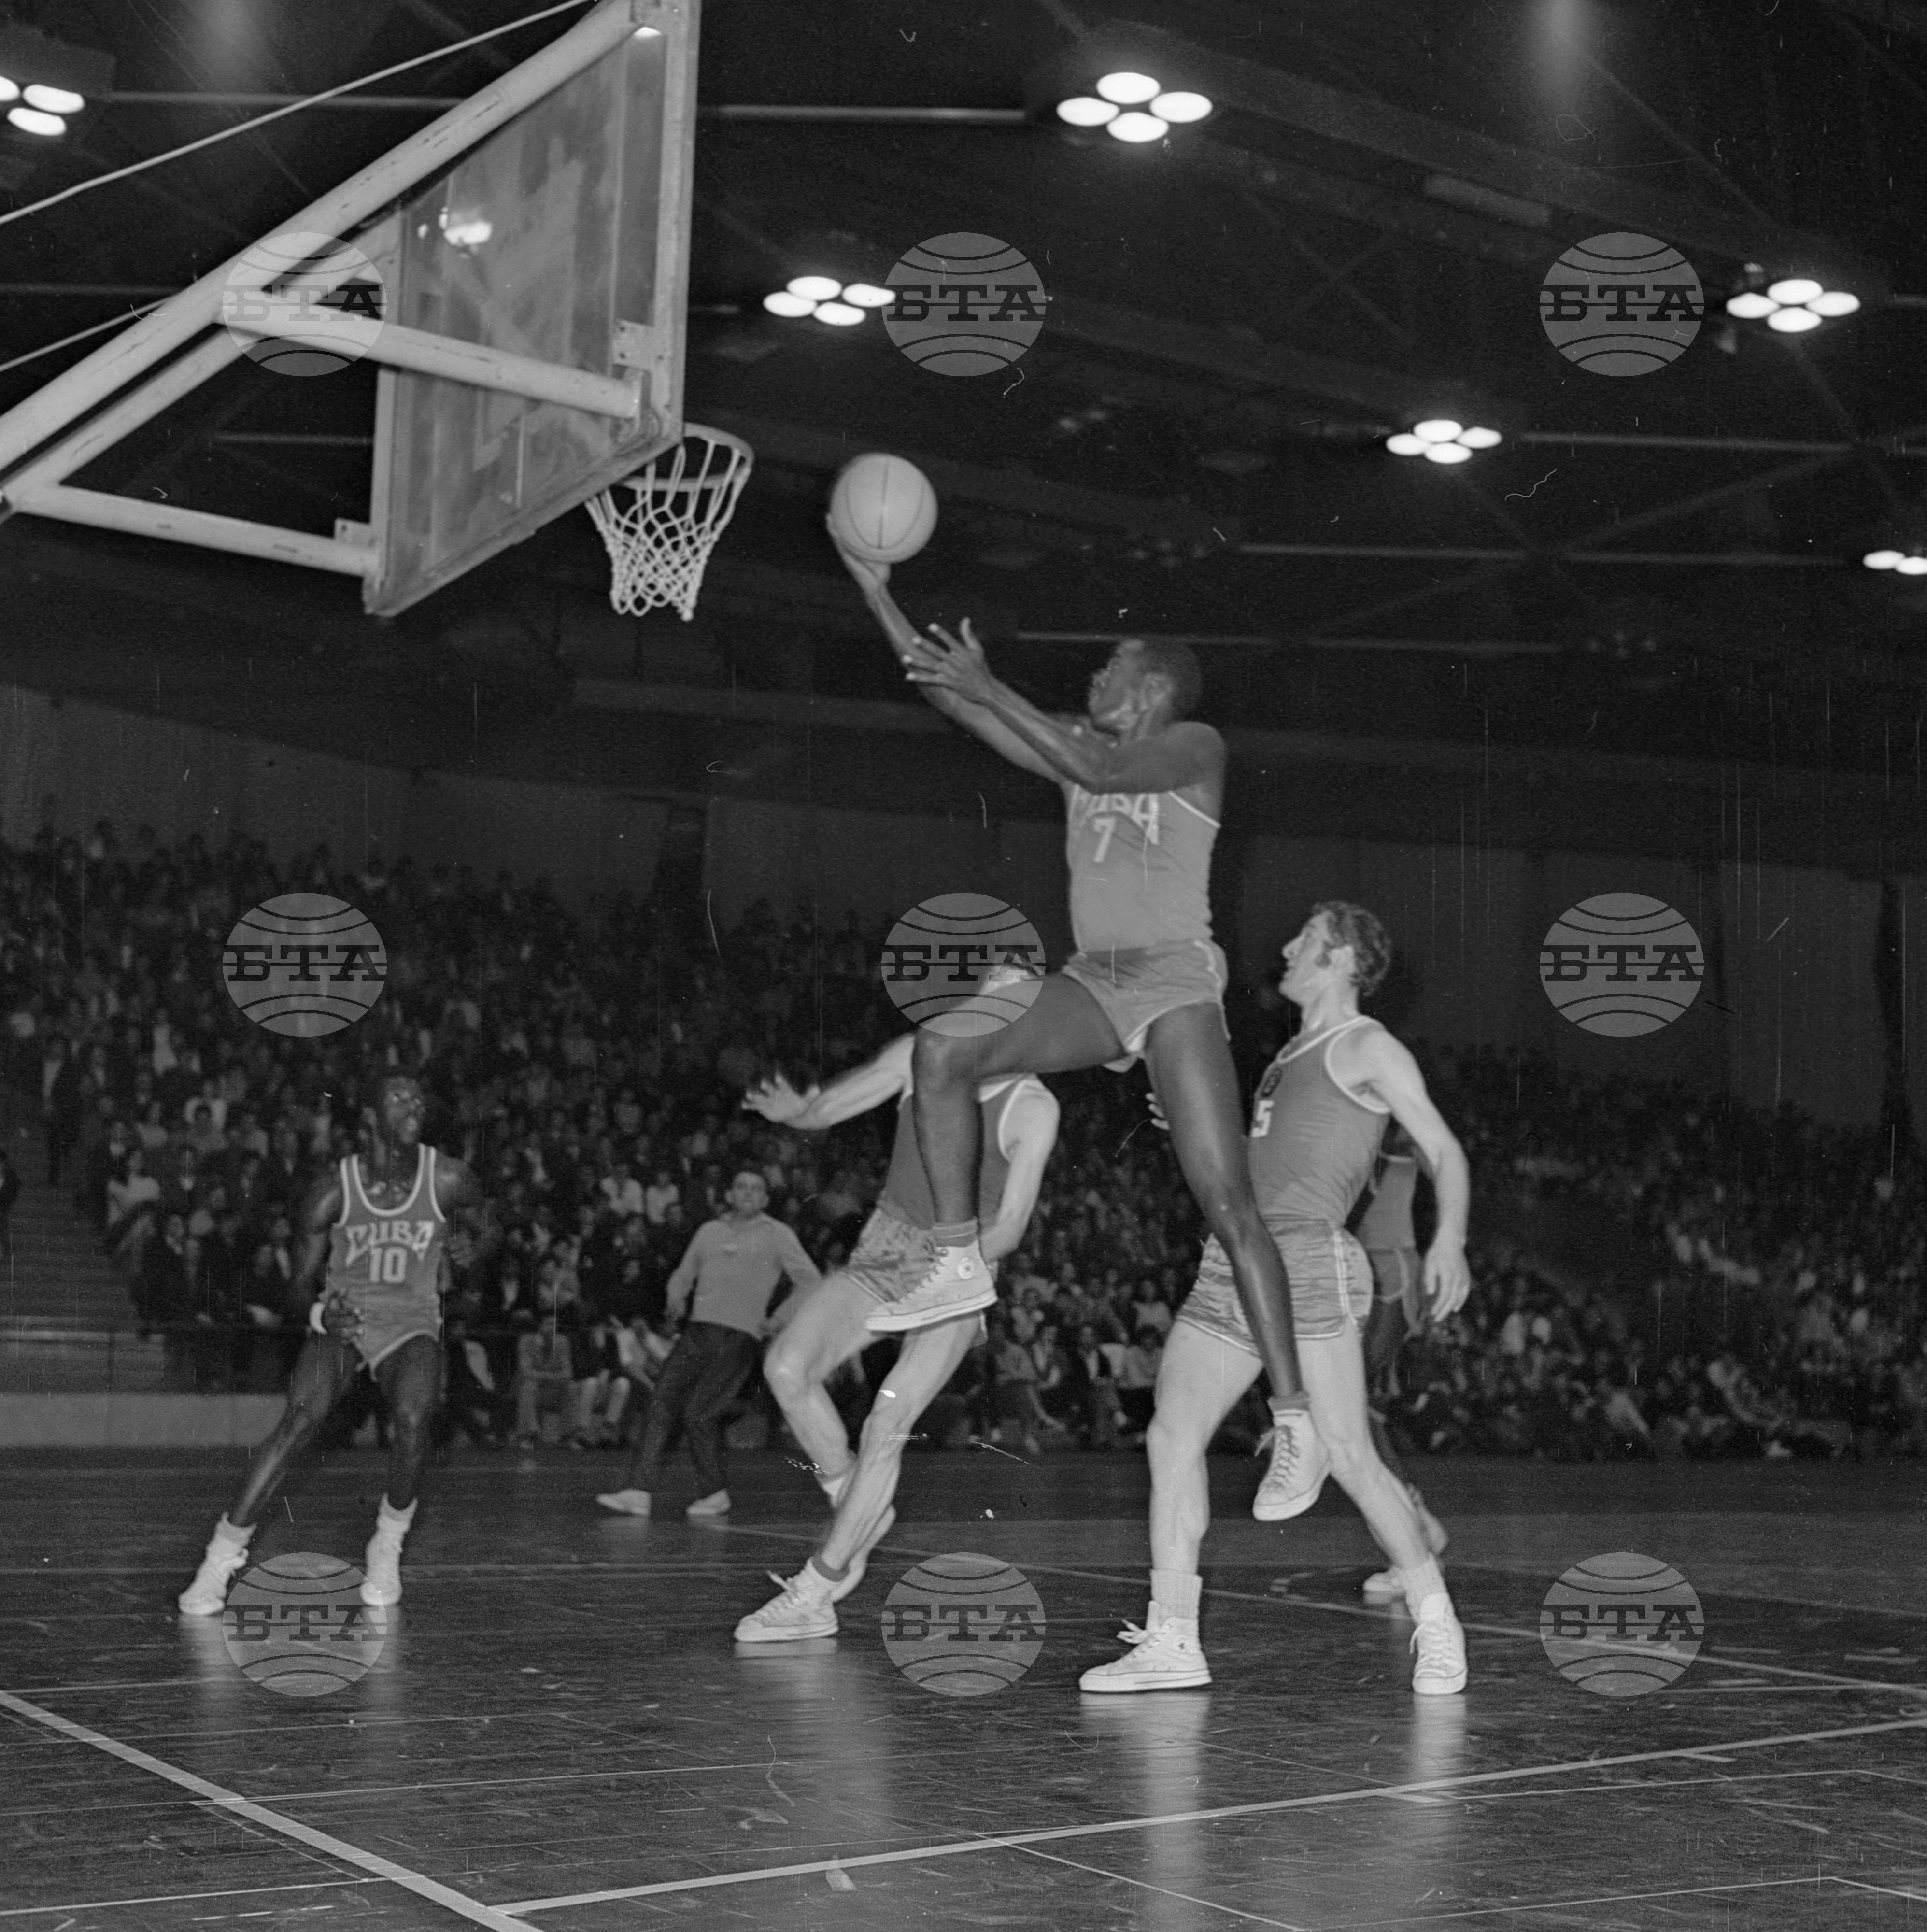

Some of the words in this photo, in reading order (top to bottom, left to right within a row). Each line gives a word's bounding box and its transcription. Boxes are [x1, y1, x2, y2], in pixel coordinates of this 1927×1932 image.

[1094, 817, 1116, 863] 7
[346, 1220, 434, 1265] CUBA
[370, 1247, 407, 1282] 10
